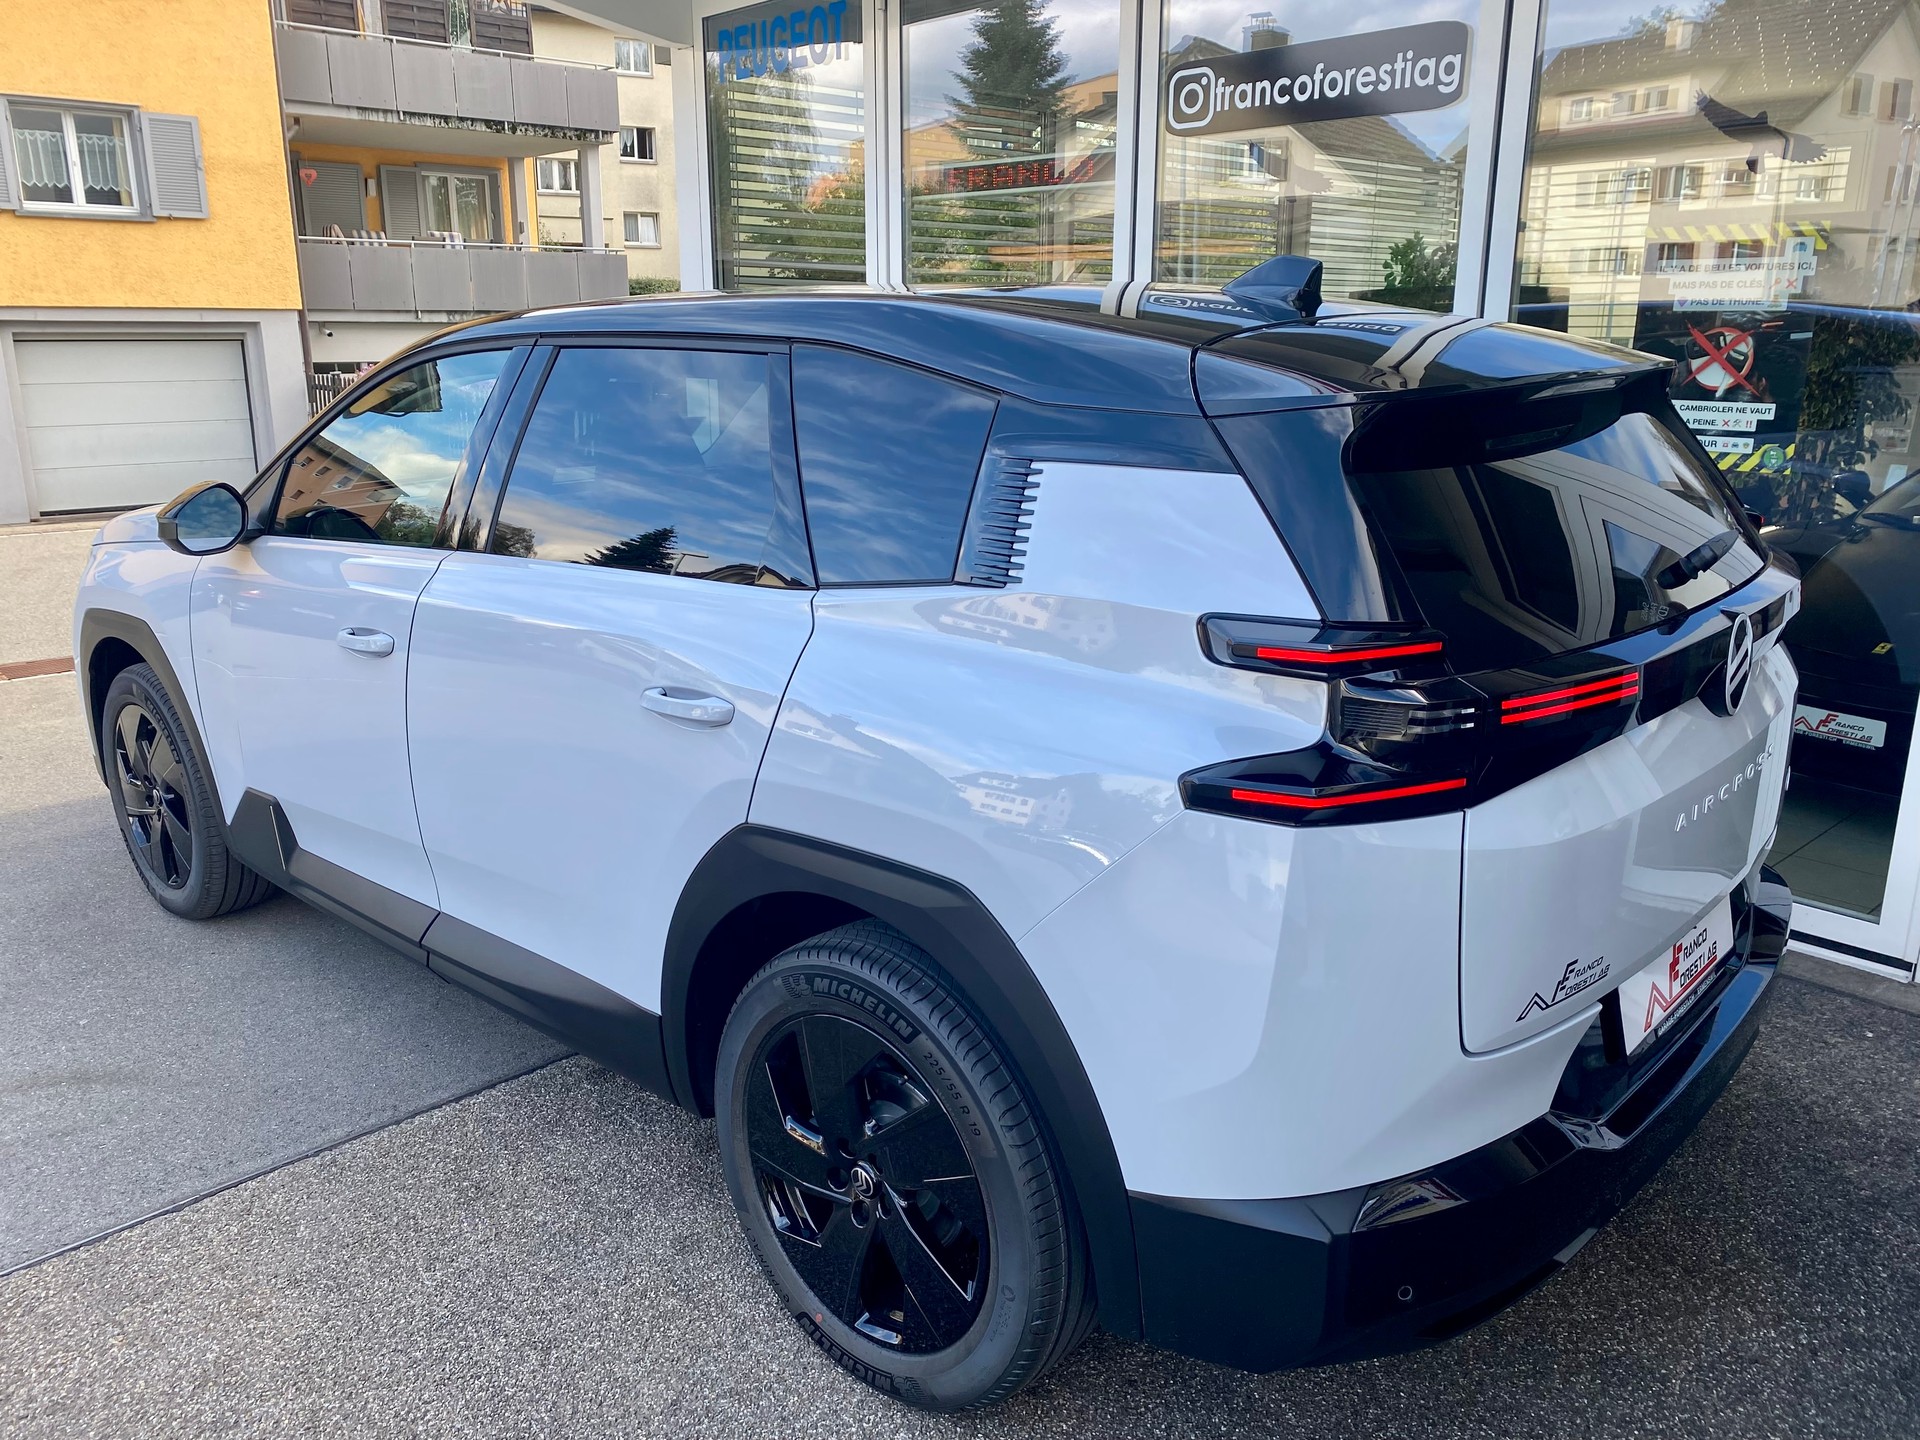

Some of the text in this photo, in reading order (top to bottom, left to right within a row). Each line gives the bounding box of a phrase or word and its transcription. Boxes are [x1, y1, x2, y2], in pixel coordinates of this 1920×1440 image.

[717, 0, 847, 85] PEUGEOT
[1215, 50, 1462, 112] francoforestiag
[946, 157, 1094, 190] FRANCO
[1672, 278, 1765, 289] MAIS PAS DE CLÉS.
[1679, 265, 1686, 273] A
[1688, 264, 1702, 273] DE
[1744, 261, 1796, 272] VOITURES
[1690, 297, 1764, 306] PAS DE THUNE.
[1679, 404, 1773, 415] CAMBRIOLER NE VAUT
[1692, 418, 1719, 427] PEINE.
[1815, 719, 1874, 742] FORESTI AG
[1822, 712, 1865, 732] FRANCO
[1674, 743, 1774, 832] AIRCROSS
[1671, 927, 1708, 968] FRANCO
[1551, 963, 1611, 1003] FORESTI AG
[1560, 955, 1604, 985] FRANCO
[1668, 940, 1718, 1000] FORESTI AG
[813, 977, 913, 1038] MICHELIN
[923, 1051, 982, 1137] 225/55 R 19
[801, 1316, 892, 1391] MICHELIN
